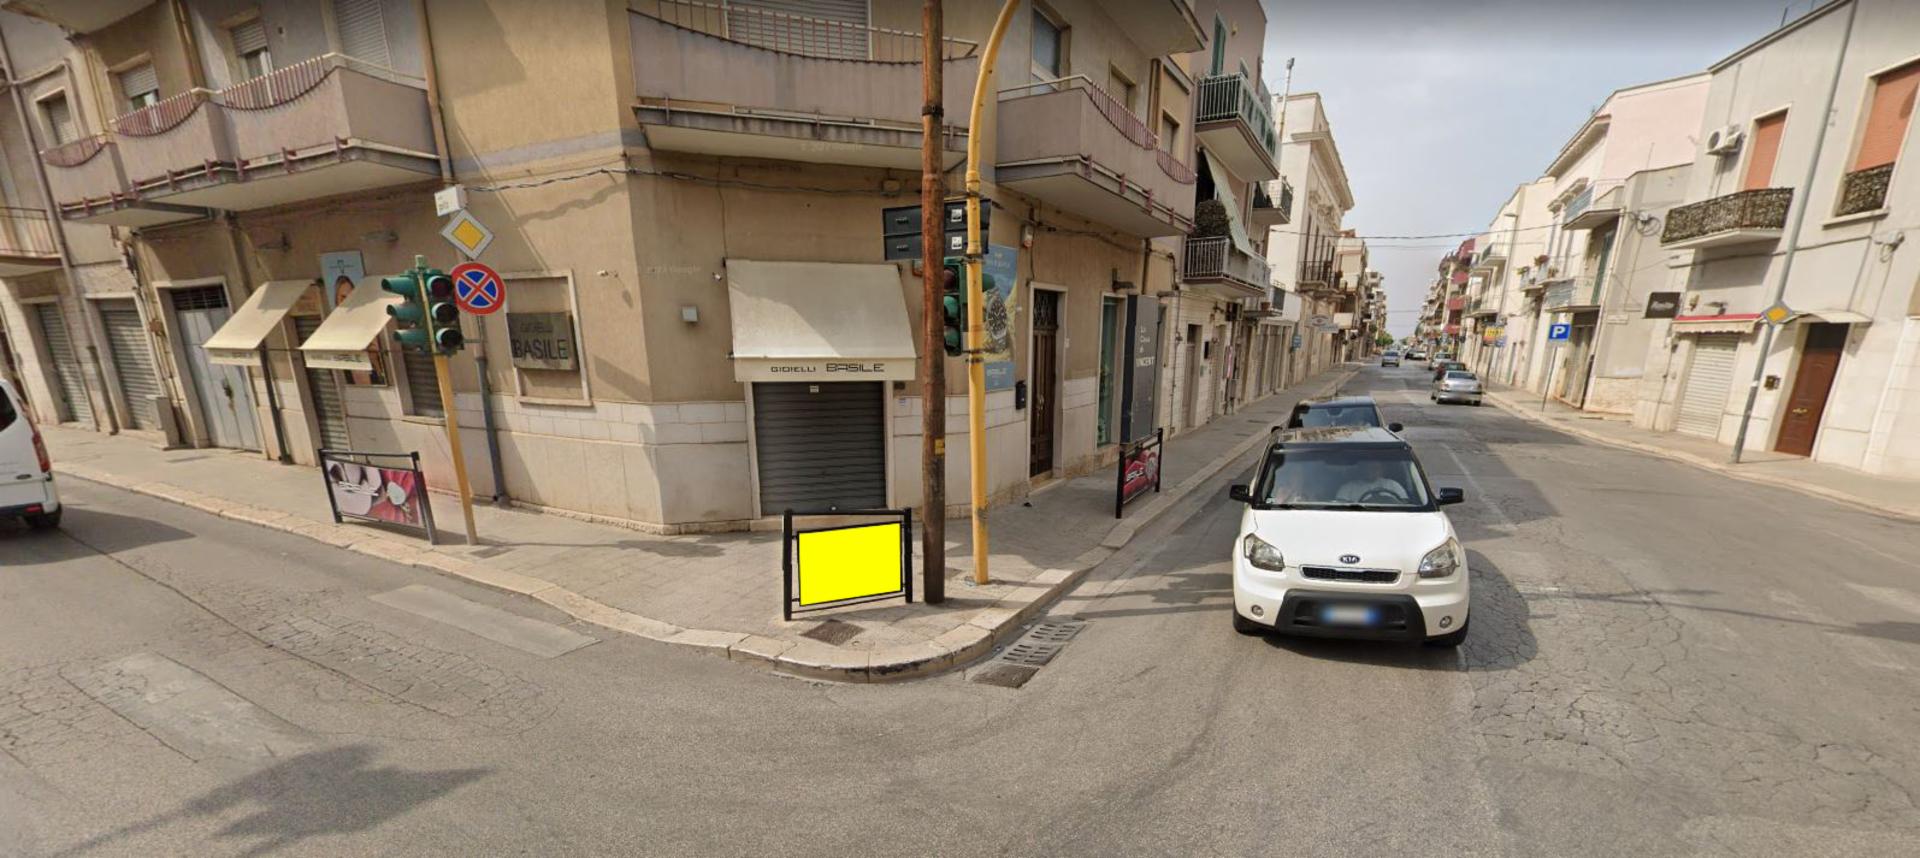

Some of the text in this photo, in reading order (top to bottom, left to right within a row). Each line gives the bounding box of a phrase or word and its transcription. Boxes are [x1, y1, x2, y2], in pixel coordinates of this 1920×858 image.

[1552, 325, 1566, 338] P
[511, 338, 569, 360] BASILE
[825, 362, 885, 373] BASILE
[1341, 555, 1358, 564] KIA
